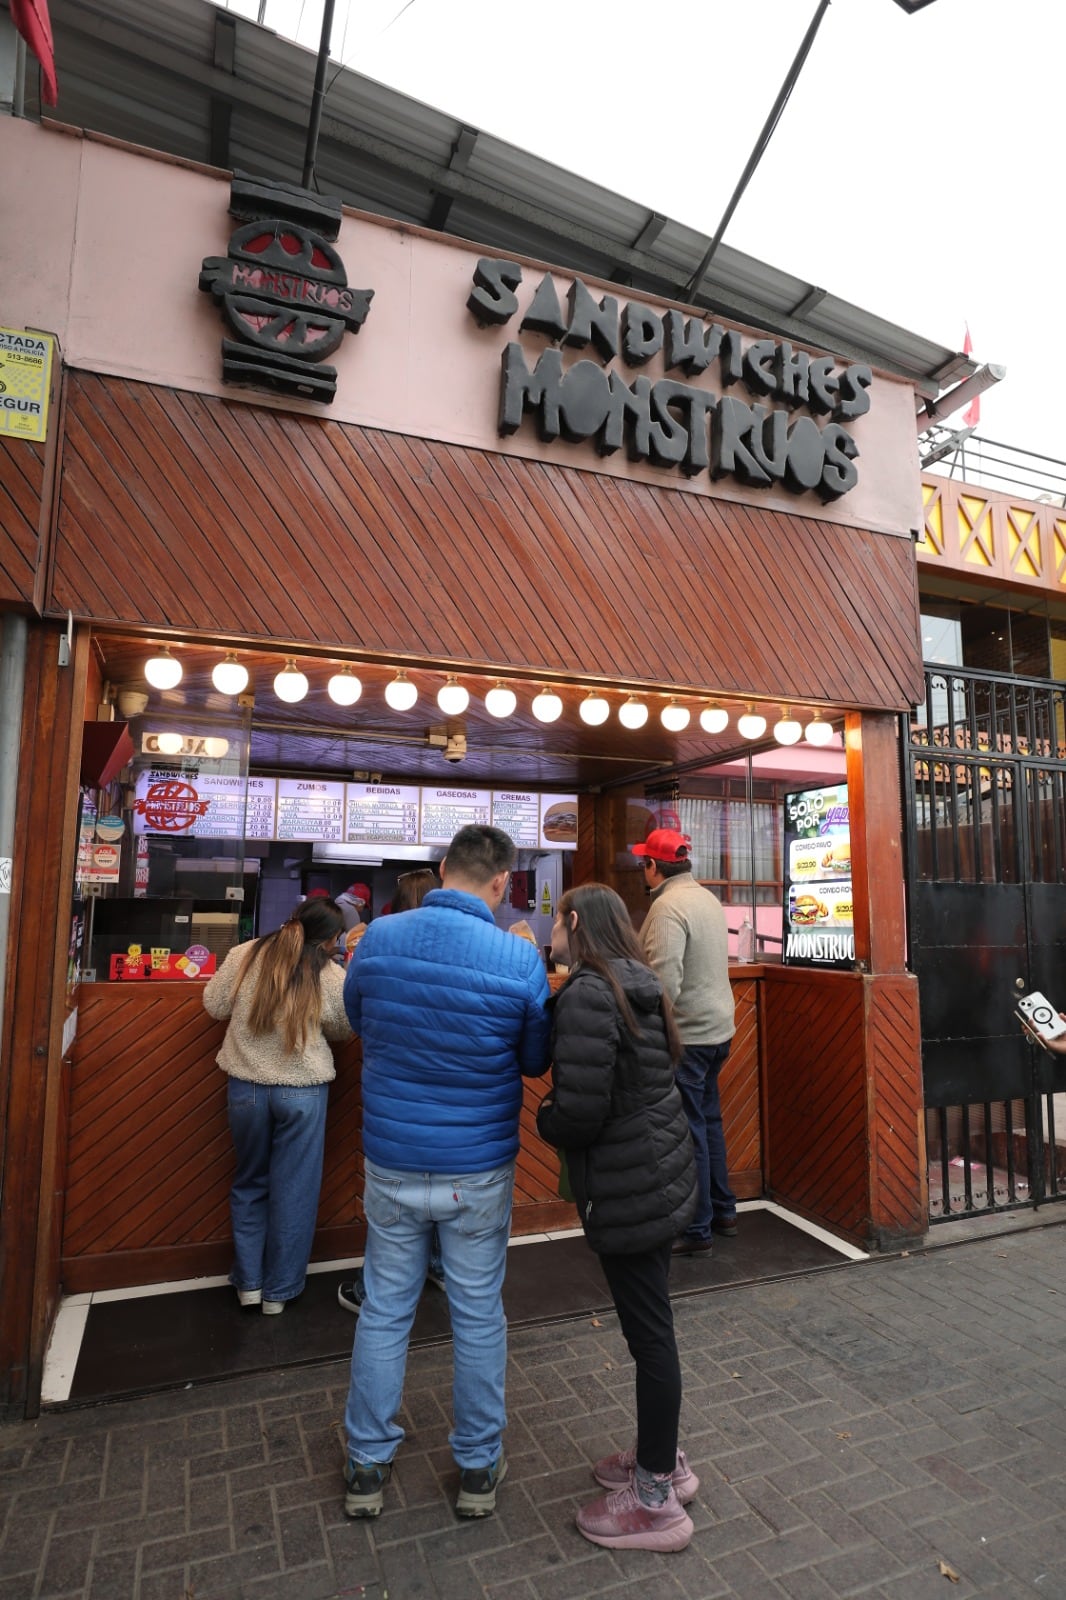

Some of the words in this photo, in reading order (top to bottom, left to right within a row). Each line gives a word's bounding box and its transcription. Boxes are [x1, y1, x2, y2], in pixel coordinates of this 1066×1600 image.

[232, 264, 354, 312] MONSTRUOS
[467, 258, 872, 422] SANDWICHES
[499, 341, 859, 505] MONSTRUOS
[145, 735, 208, 755] CJA
[297, 783, 327, 791] ZUMOS
[366, 786, 400, 795] BEBIDAS
[436, 790, 477, 799] GASEOSAS
[501, 793, 531, 802] CREMAS
[790, 795, 824, 821] SOLO
[796, 813, 820, 832] POR
[820, 806, 850, 834] yap
[786, 933, 856, 961] MONSTRUO
